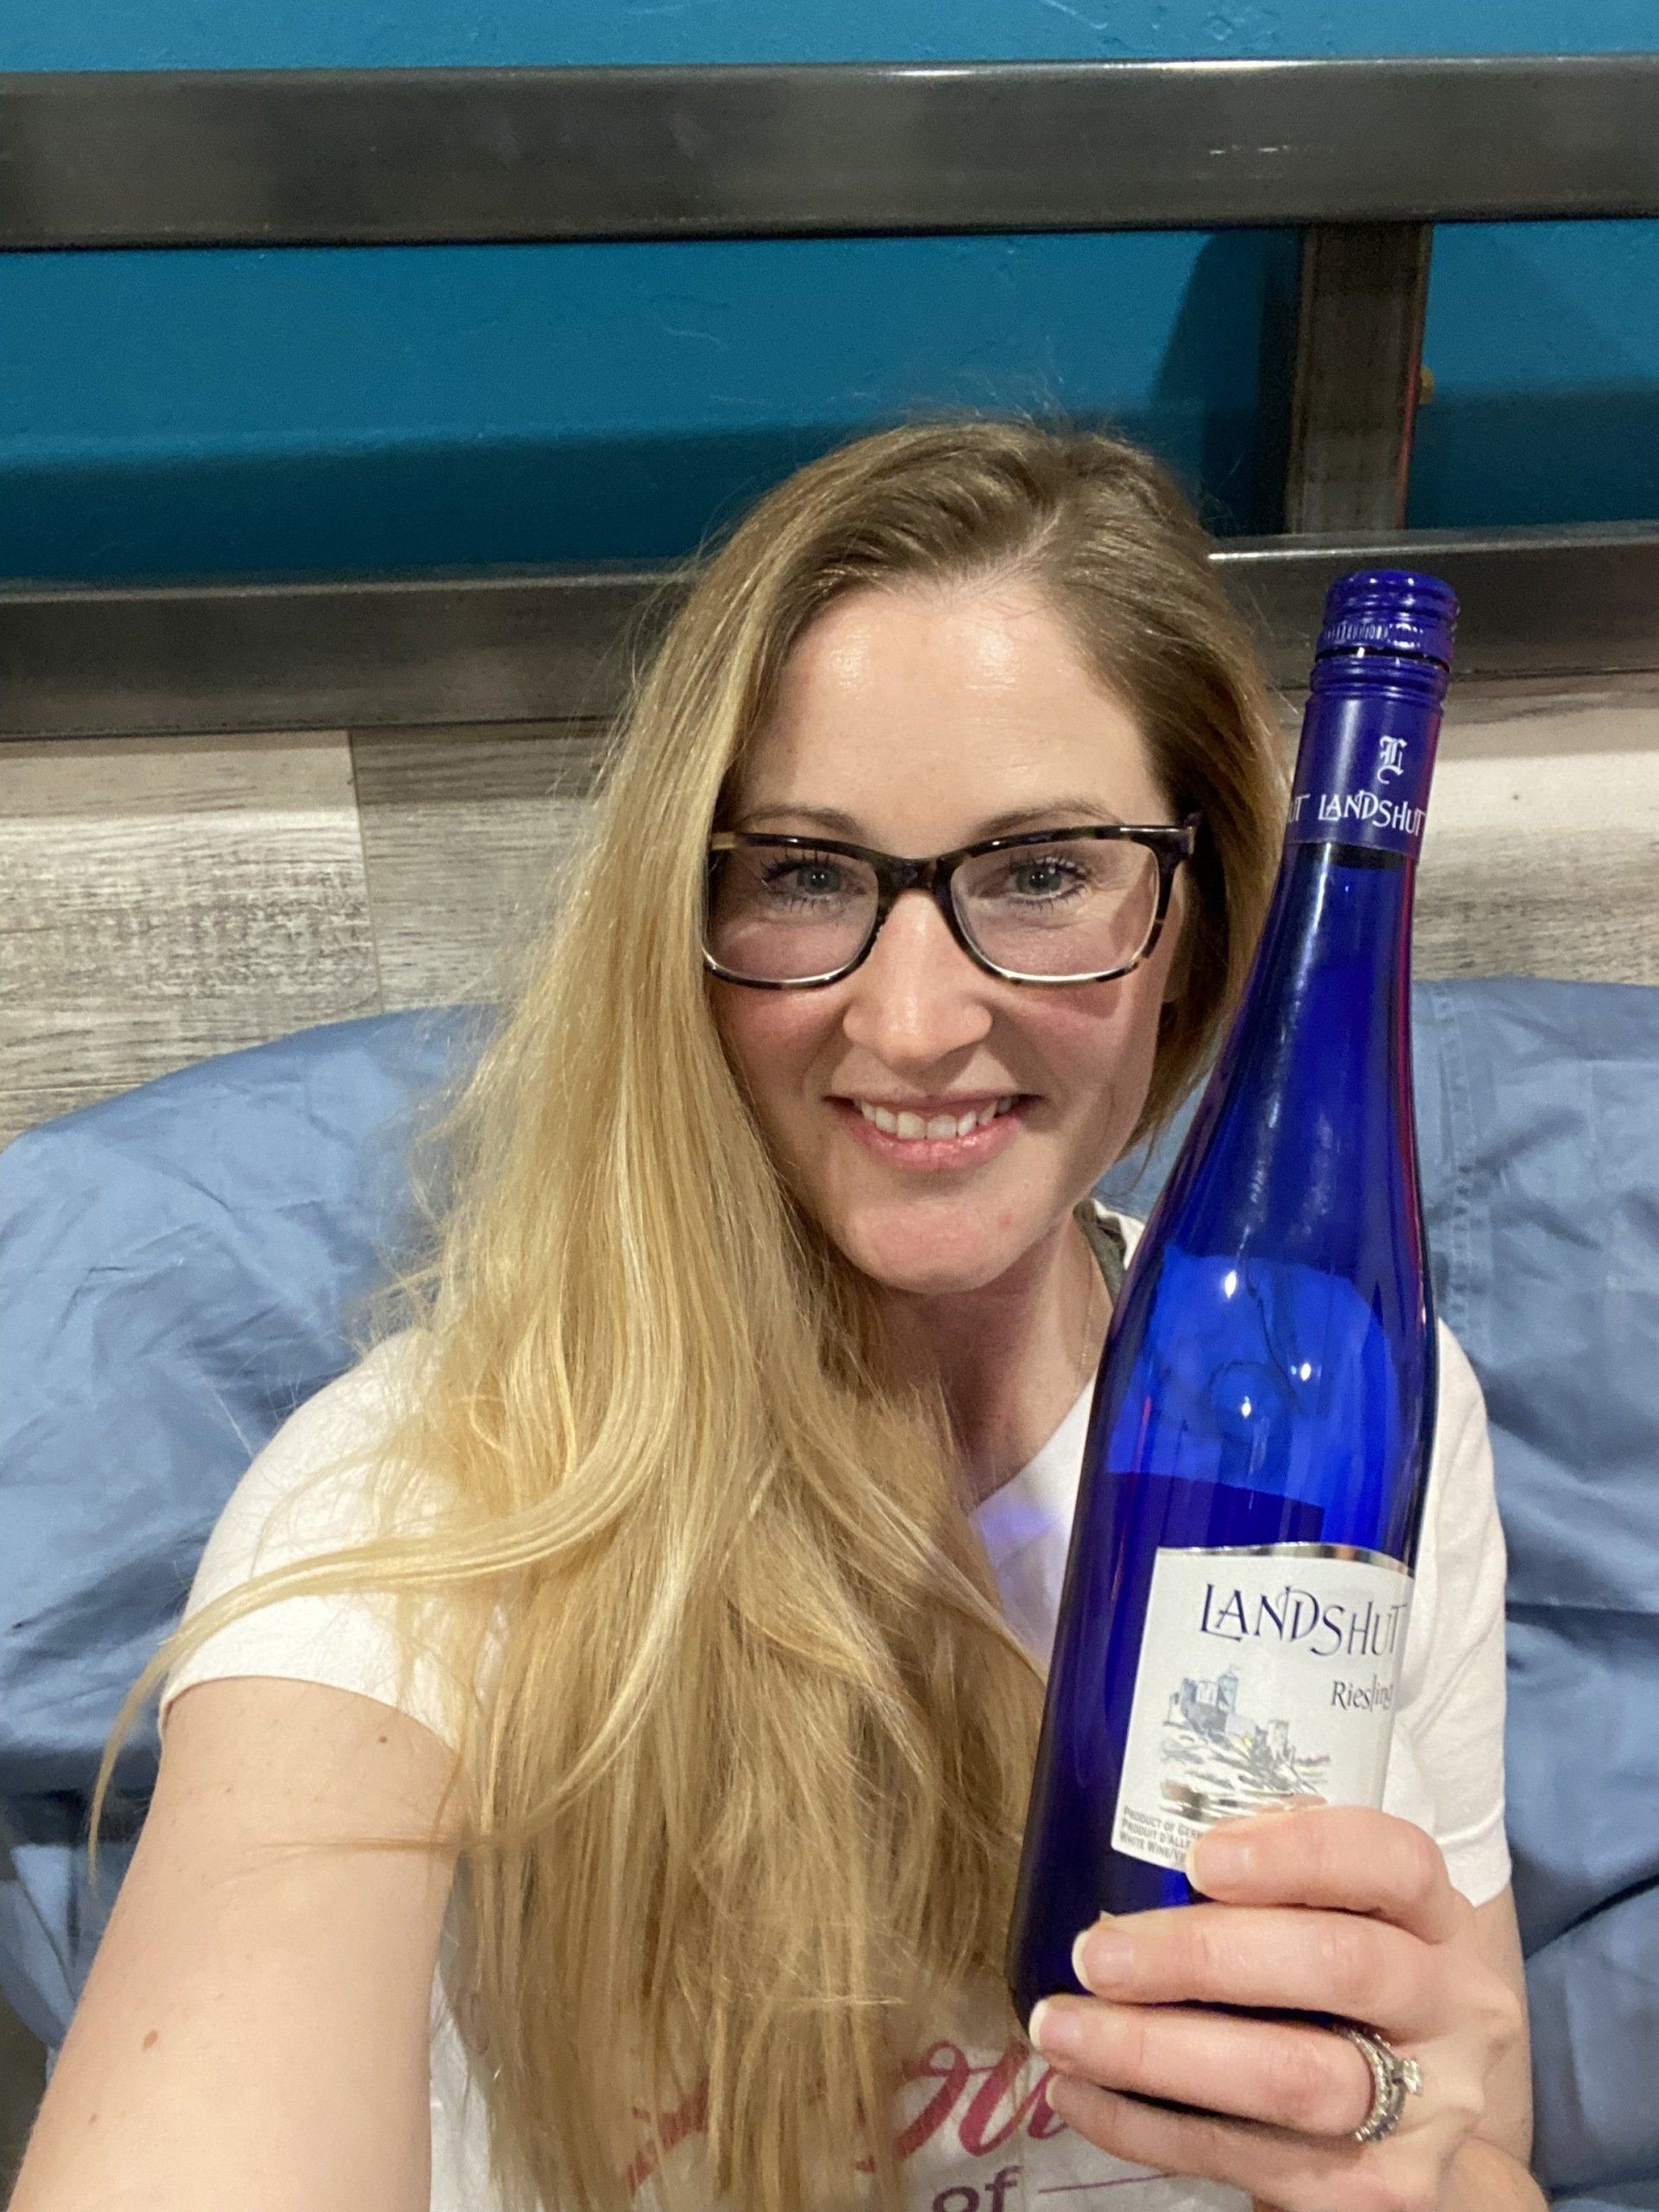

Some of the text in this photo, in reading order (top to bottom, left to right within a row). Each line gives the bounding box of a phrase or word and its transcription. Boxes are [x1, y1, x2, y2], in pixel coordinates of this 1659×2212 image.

[1318, 788, 1427, 836] LANDSHUT
[1199, 1583, 1408, 1656] LANDSHUT
[1331, 1674, 1394, 1712] Riesling
[1122, 1818, 1158, 1839] PRODUIT
[1124, 1805, 1162, 1827] PRODUCT
[1163, 1821, 1176, 1832] OF
[1120, 1831, 1145, 1849] WHITE
[932, 2165, 1023, 2212] of
